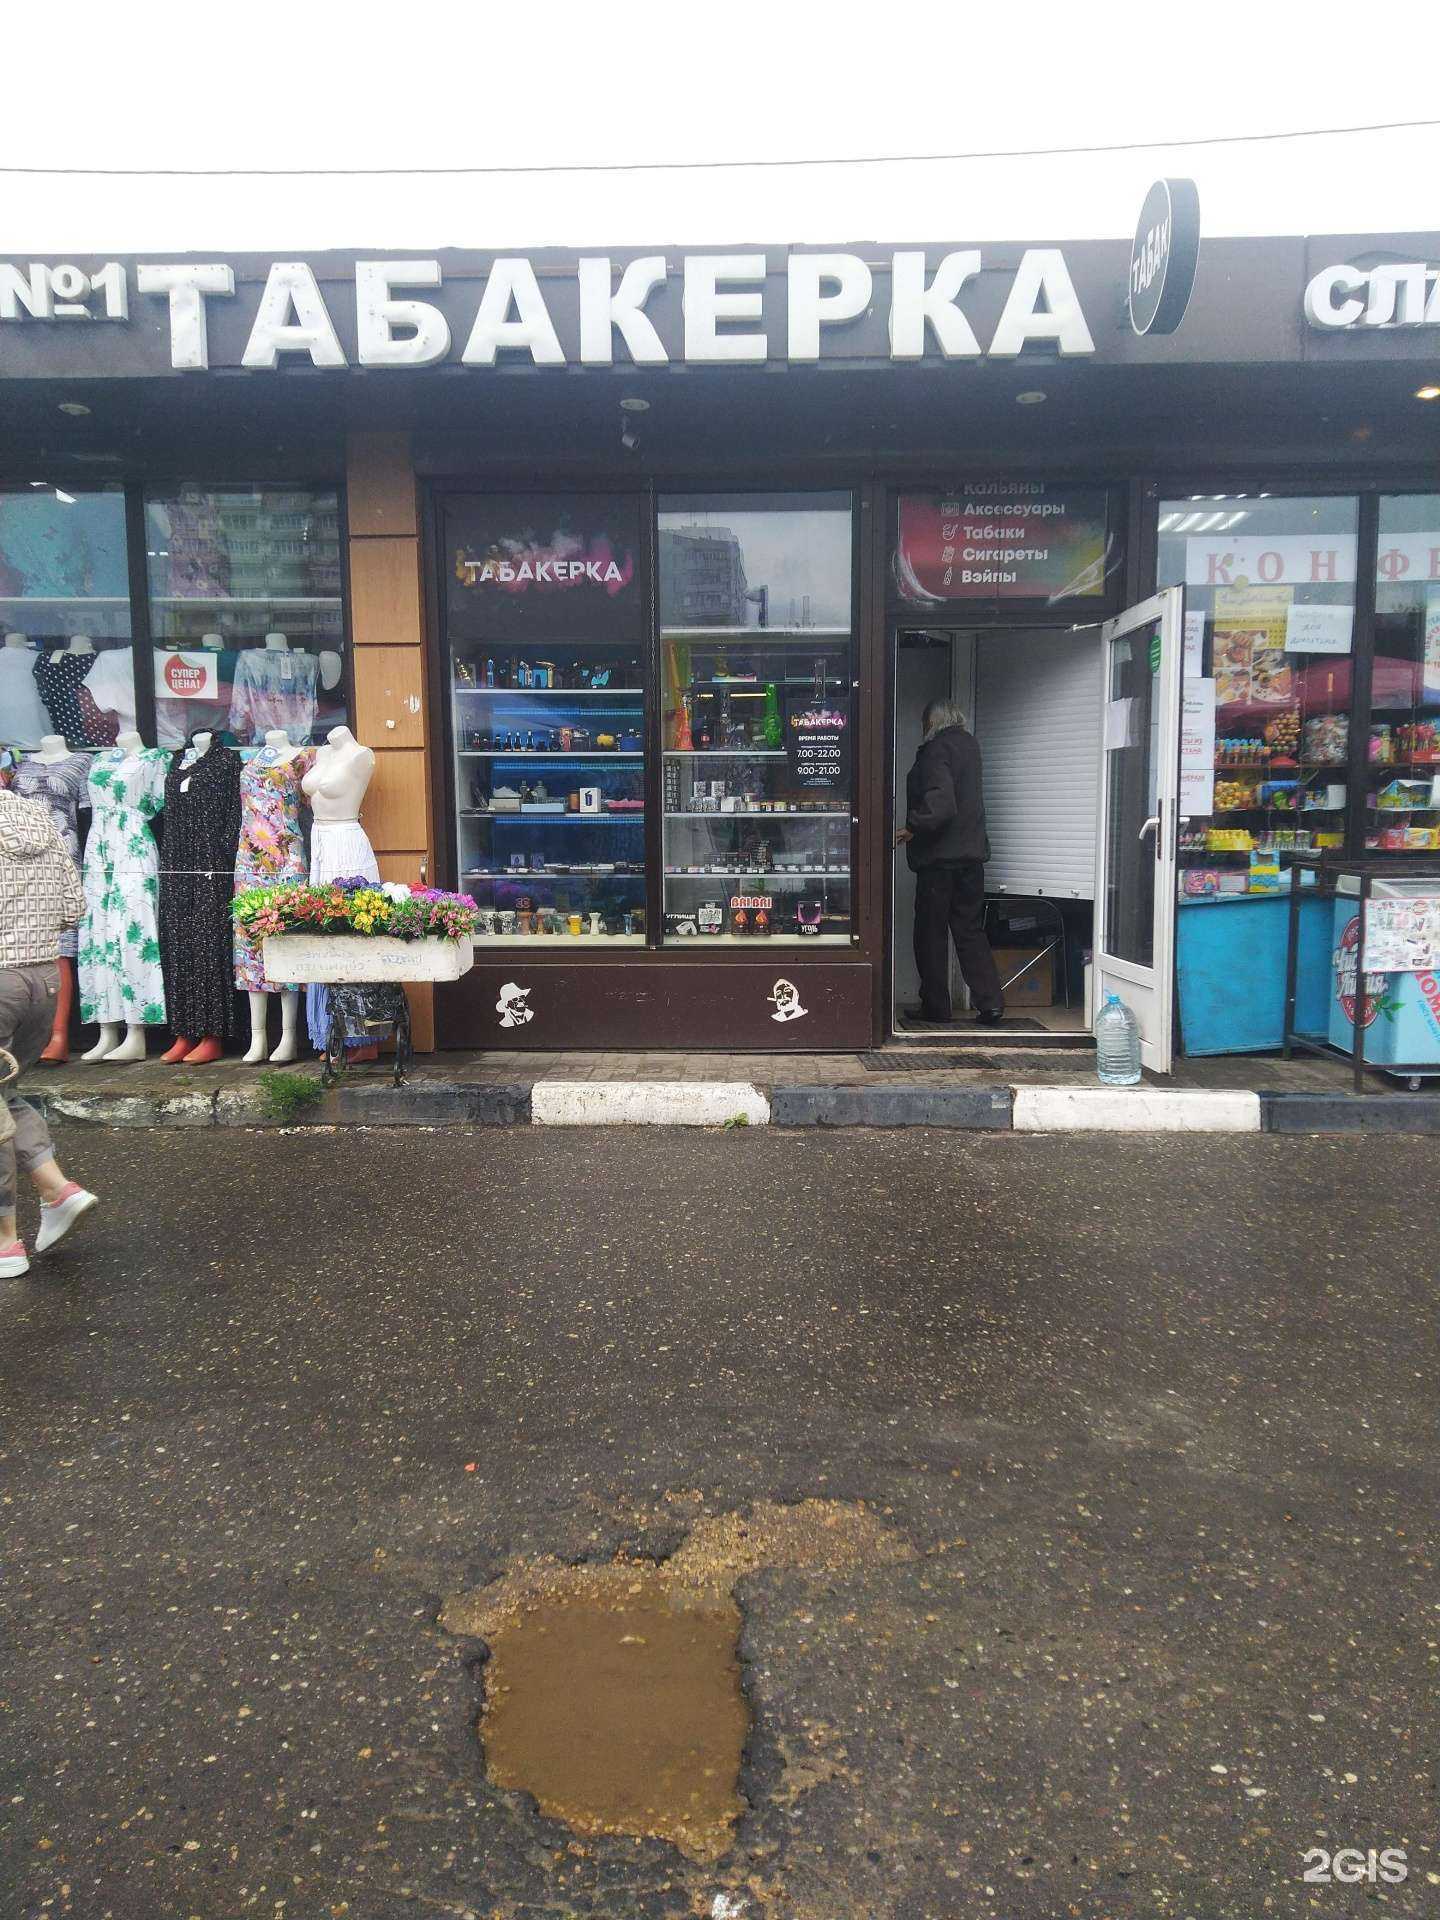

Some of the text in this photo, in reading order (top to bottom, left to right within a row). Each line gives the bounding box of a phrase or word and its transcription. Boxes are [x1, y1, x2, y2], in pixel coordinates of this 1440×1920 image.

[1132, 217, 1169, 295] ТАБАК
[1304, 263, 1440, 328] СЛ
[137, 248, 1096, 370] ТАБАКЕРКА
[964, 503, 1065, 517] Аксессуары
[963, 525, 1025, 539] Табаки
[962, 548, 1048, 563] Сигареты
[465, 561, 623, 582] ТАБАКЕРКА
[962, 569, 1017, 583] Вэйпы
[172, 669, 200, 678] СУПЕР
[172, 679, 201, 689] ЦЕНА!
[793, 718, 844, 727] ТАБАКЕРКА
[797, 749, 841, 758] 7.00-22.00
[797, 766, 841, 775] 9.00-21.00
